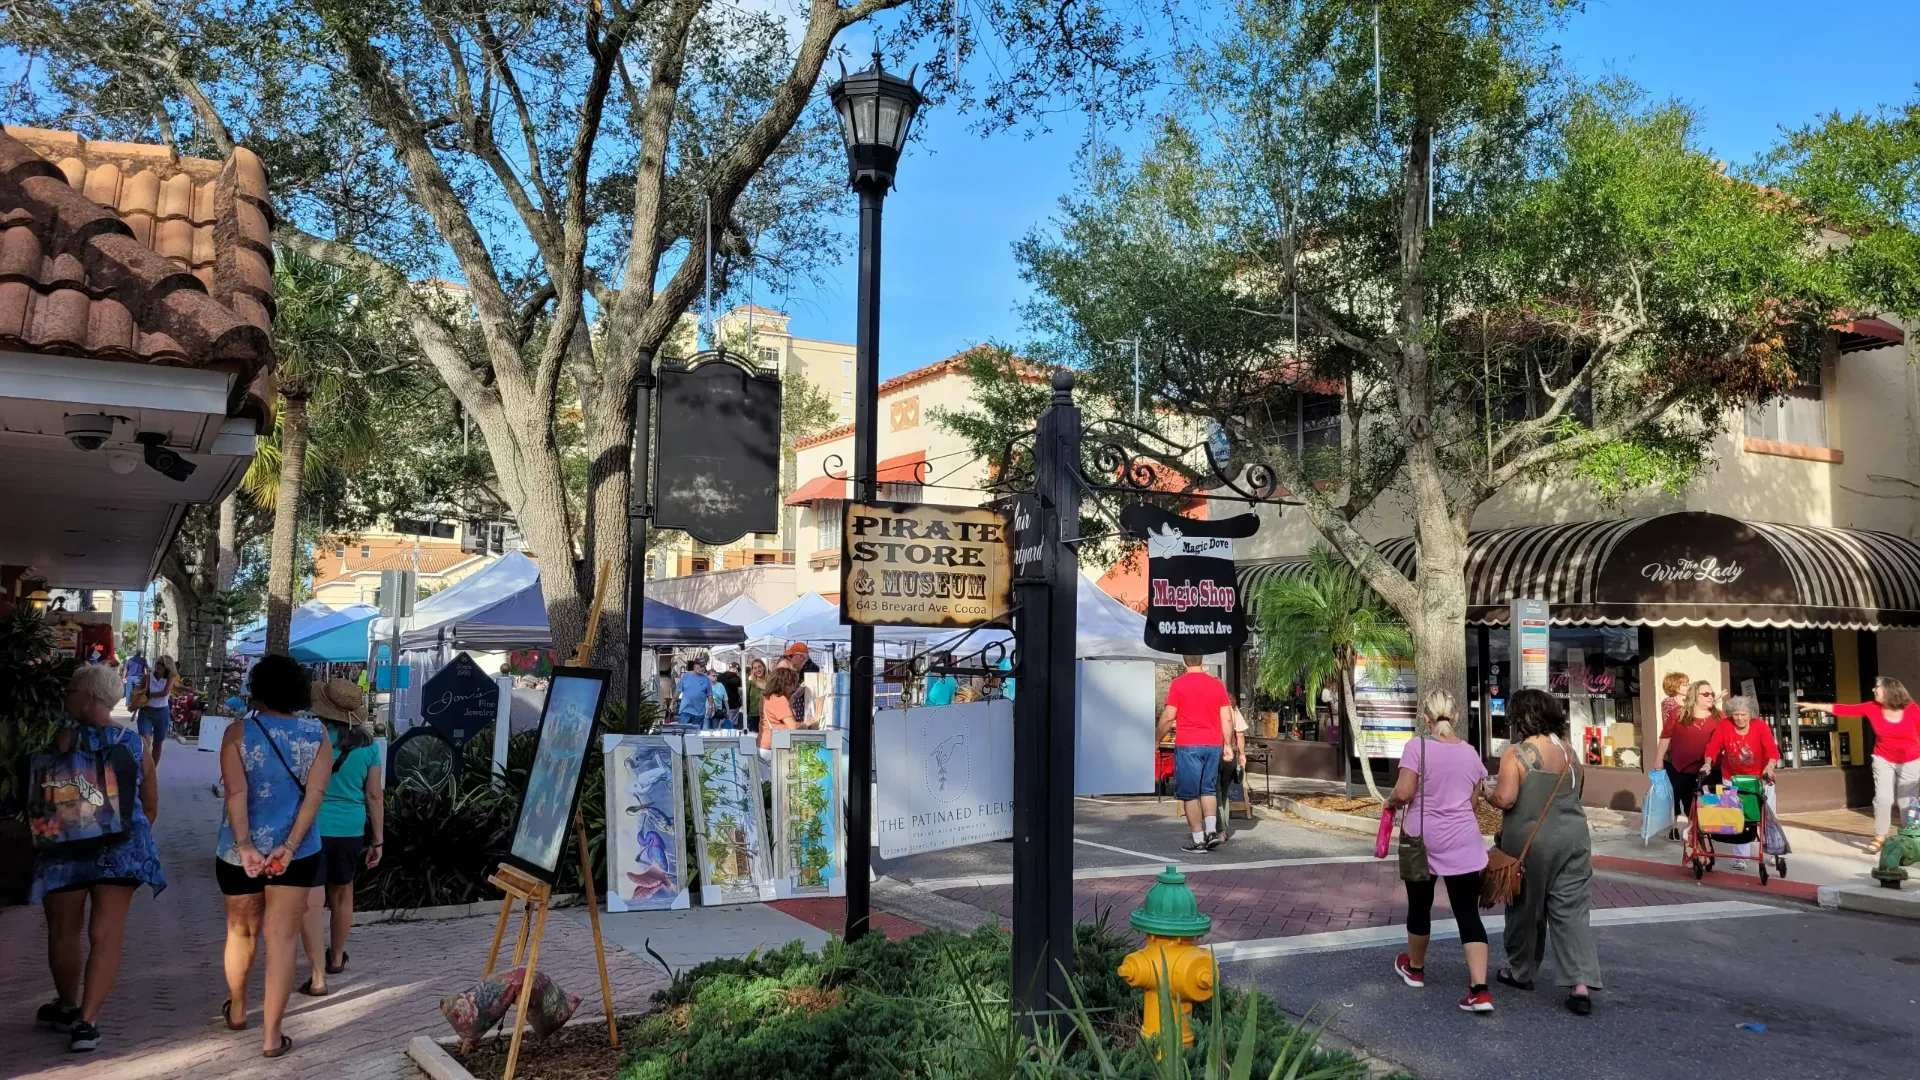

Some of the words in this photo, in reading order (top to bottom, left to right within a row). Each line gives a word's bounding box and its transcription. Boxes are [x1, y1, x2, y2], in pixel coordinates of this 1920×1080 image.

[851, 515, 1004, 544] PIRATE
[852, 541, 986, 568] STORE
[1182, 540, 1208, 556] Magic
[1209, 538, 1229, 550] Dove
[1641, 562, 1694, 582] Wine
[1694, 557, 1745, 584] Lady
[1677, 558, 1699, 571] The
[854, 568, 875, 597] &
[881, 569, 987, 600] MUSEUM
[1152, 578, 1198, 612] Magic
[1198, 579, 1236, 613] Shop
[856, 600, 878, 611] 643
[881, 601, 925, 613] Brevard
[927, 602, 951, 614] Ave,
[954, 603, 987, 615] Cocoa
[1158, 621, 1177, 634] 604
[1178, 621, 1215, 635] Brevard
[1216, 621, 1233, 635] Ave
[463, 707, 495, 717] Jewelry
[478, 699, 496, 708] Fine
[880, 817, 906, 833] THE
[912, 806, 972, 828] PATINAED
[978, 800, 1015, 817] FLEUR
[913, 829, 934, 838] Floral
[938, 822, 986, 834] Arrangements
